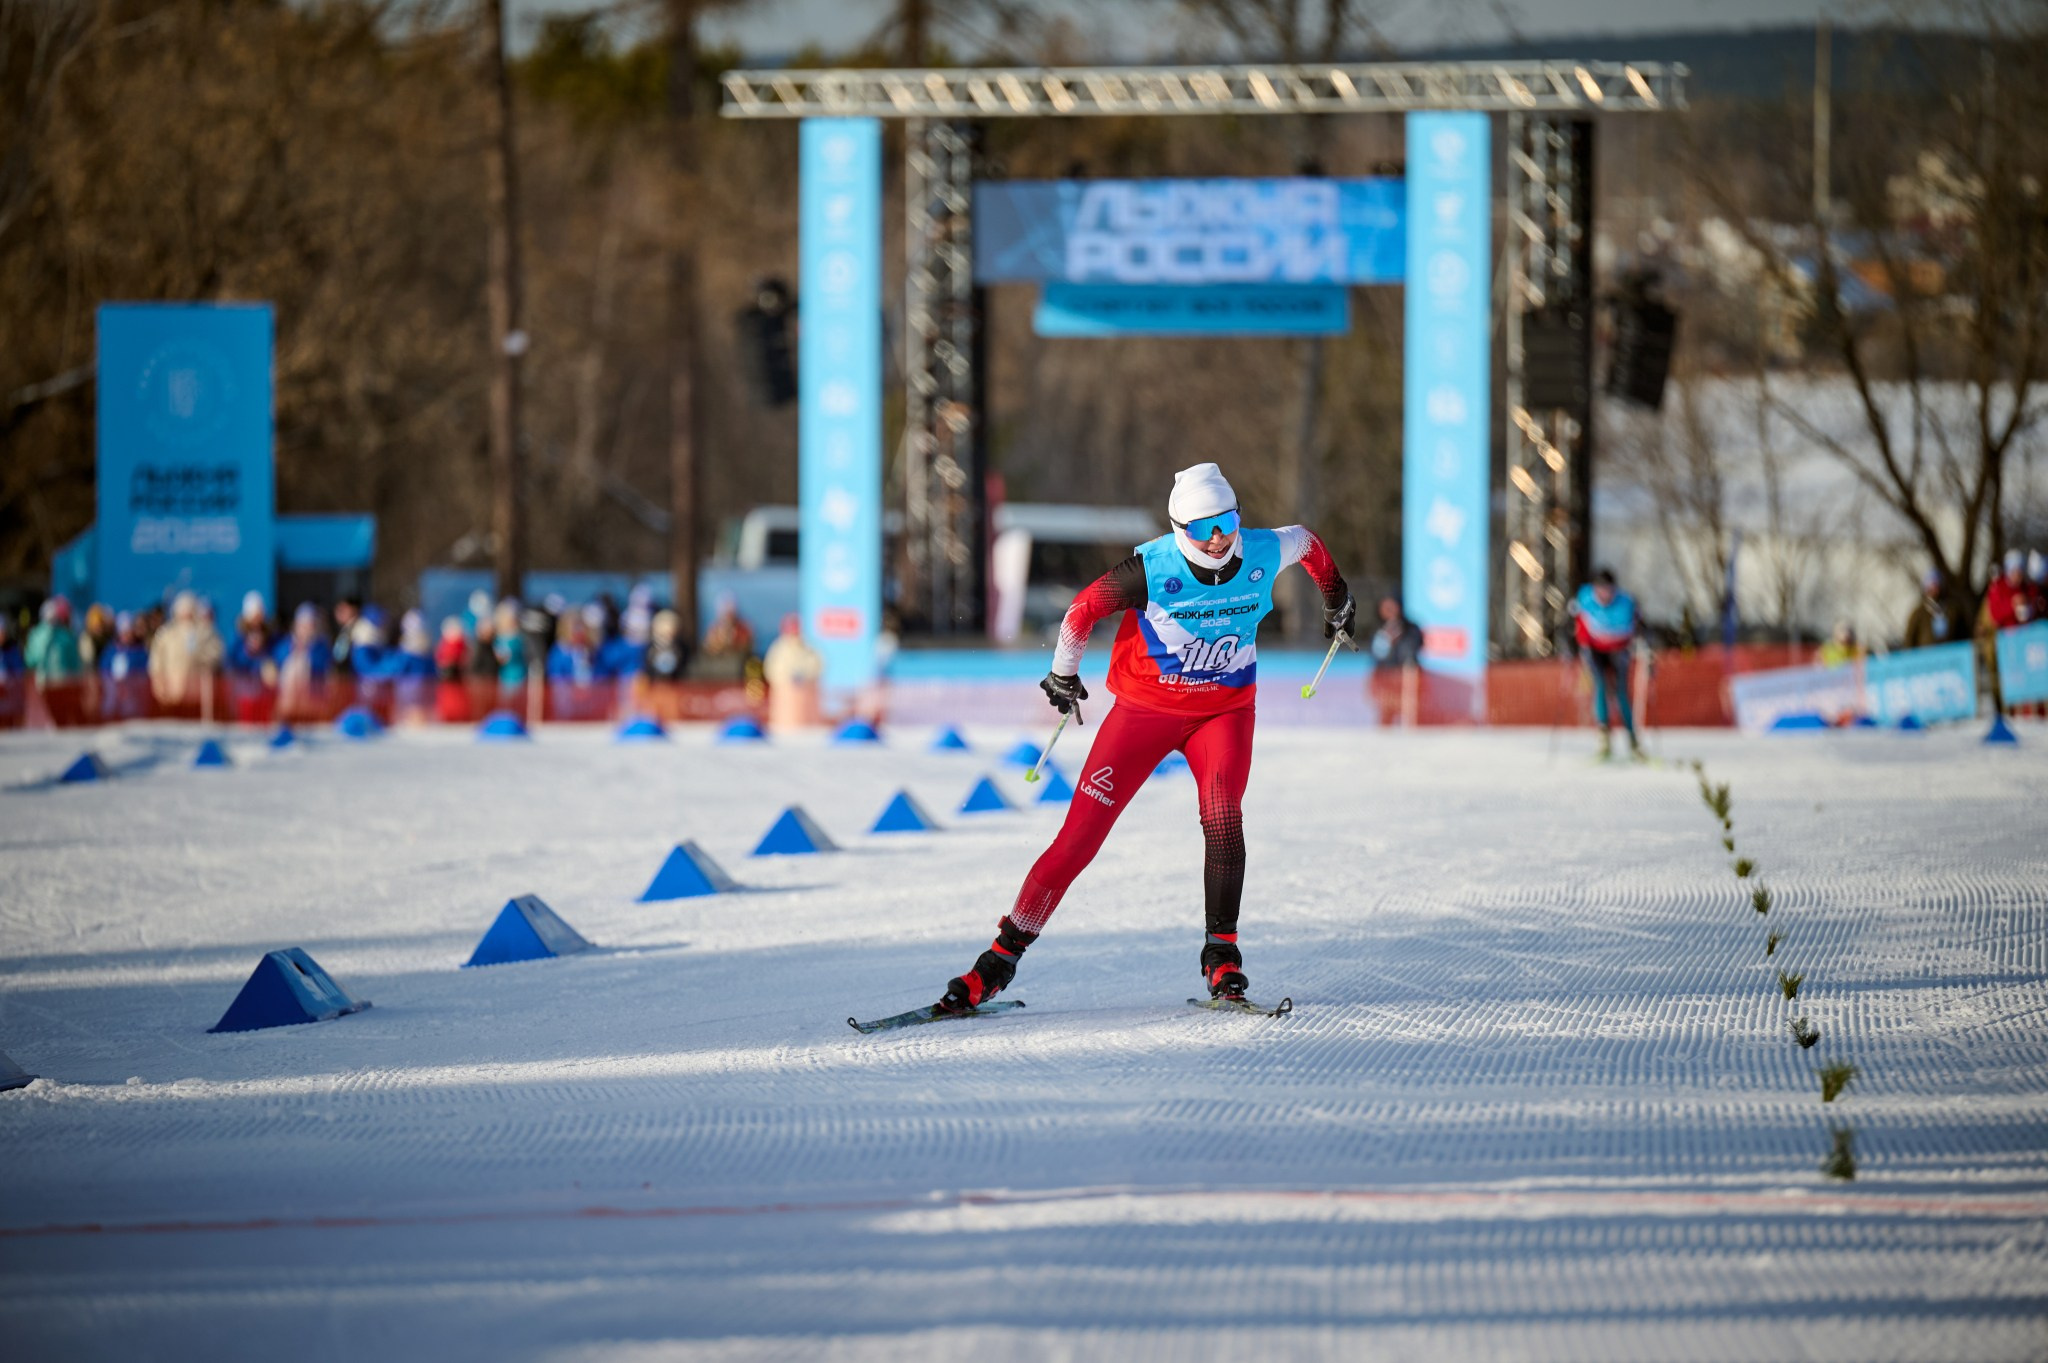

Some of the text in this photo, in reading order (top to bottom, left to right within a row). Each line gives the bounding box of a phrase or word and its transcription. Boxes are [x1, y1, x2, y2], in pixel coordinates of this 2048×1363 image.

[1066, 230, 1349, 282] РОССИИ
[1168, 602, 1259, 619] ЛЫЖНЯ РОССИИ
[1200, 617, 1231, 628] 2025
[1182, 634, 1240, 672] 10
[1080, 780, 1116, 807] Löffler
